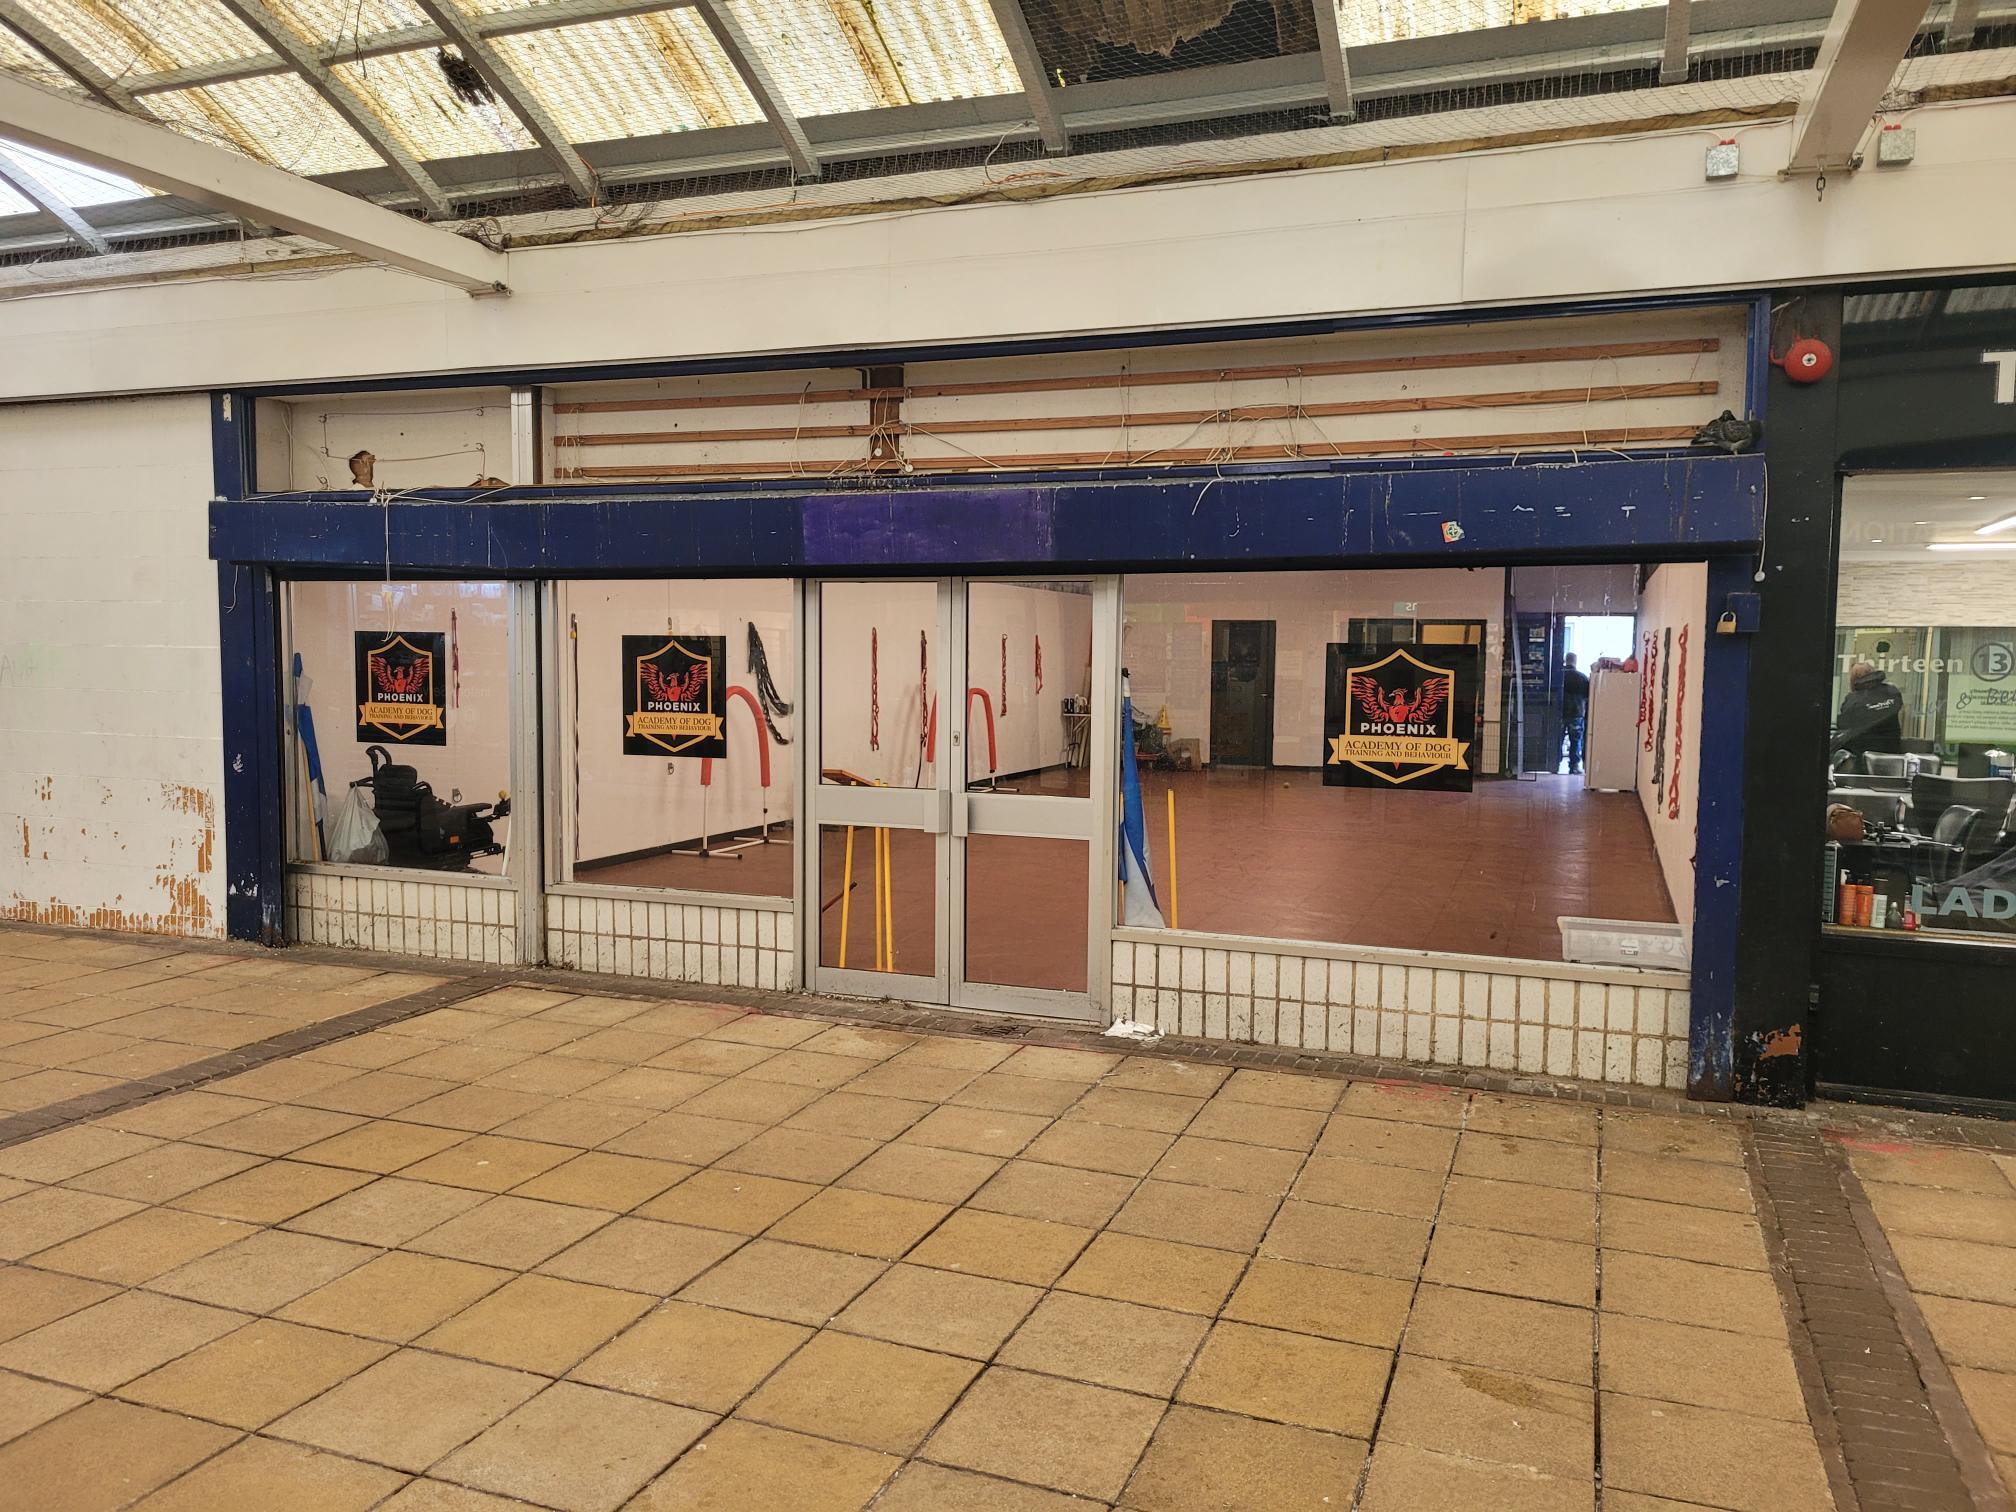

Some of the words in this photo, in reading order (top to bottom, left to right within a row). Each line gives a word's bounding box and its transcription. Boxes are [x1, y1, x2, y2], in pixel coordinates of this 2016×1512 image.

[1837, 652, 1963, 673] Thirteen
[378, 693, 423, 702] PHOENIX
[370, 707, 404, 715] ACADEMY
[405, 707, 416, 715] OF
[648, 702, 700, 711] PHOENIX
[637, 716, 678, 725] ACADEMY
[679, 717, 692, 725] OF
[693, 718, 711, 726] DOG
[1360, 723, 1436, 735] PHOENIX
[1344, 740, 1402, 750] ACADEMY
[1405, 741, 1421, 751] OF
[1425, 742, 1451, 752] DOG
[1345, 749, 1383, 757] TRAINING
[1385, 750, 1403, 758] AND
[1404, 751, 1452, 760] BEHAVIOUR
[1911, 883, 2016, 920] LAD
